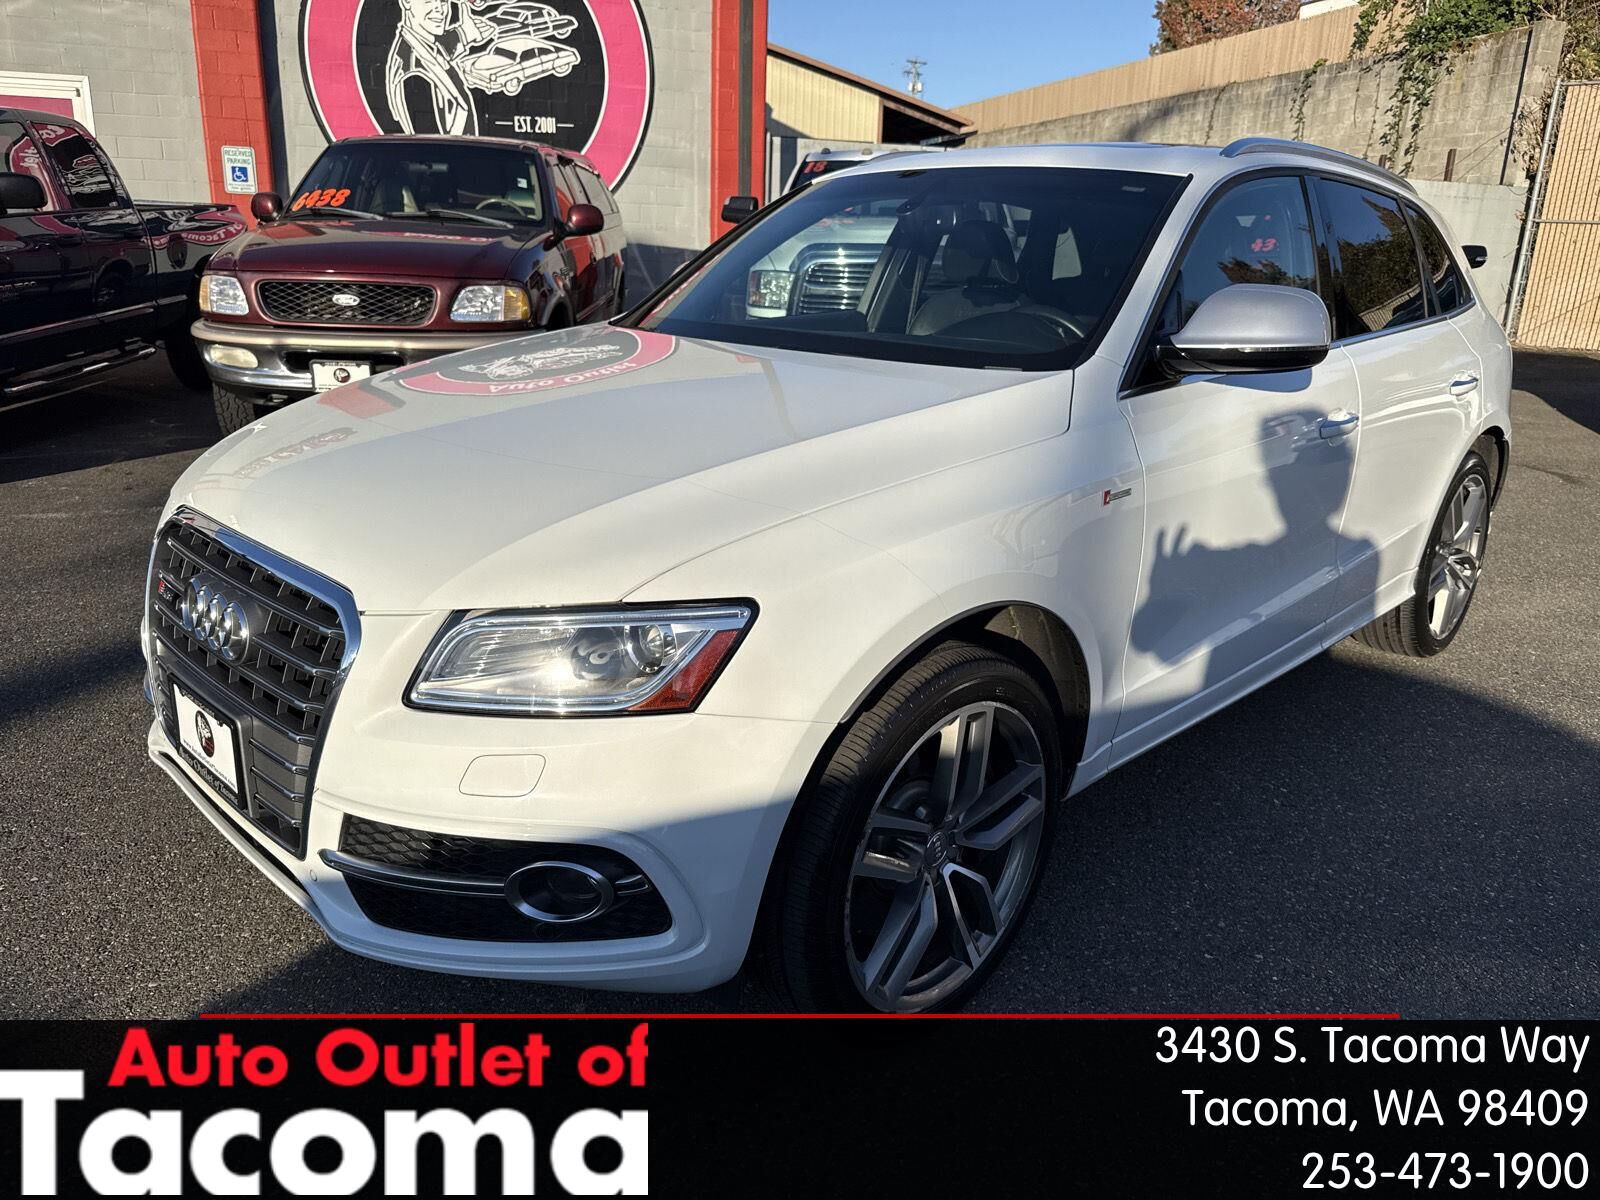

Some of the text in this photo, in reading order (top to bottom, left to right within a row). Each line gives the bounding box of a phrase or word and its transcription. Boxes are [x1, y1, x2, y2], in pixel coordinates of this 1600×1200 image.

[514, 115, 557, 134] EST. 2001
[224, 149, 253, 158] RESERVED
[226, 157, 251, 165] PARKING
